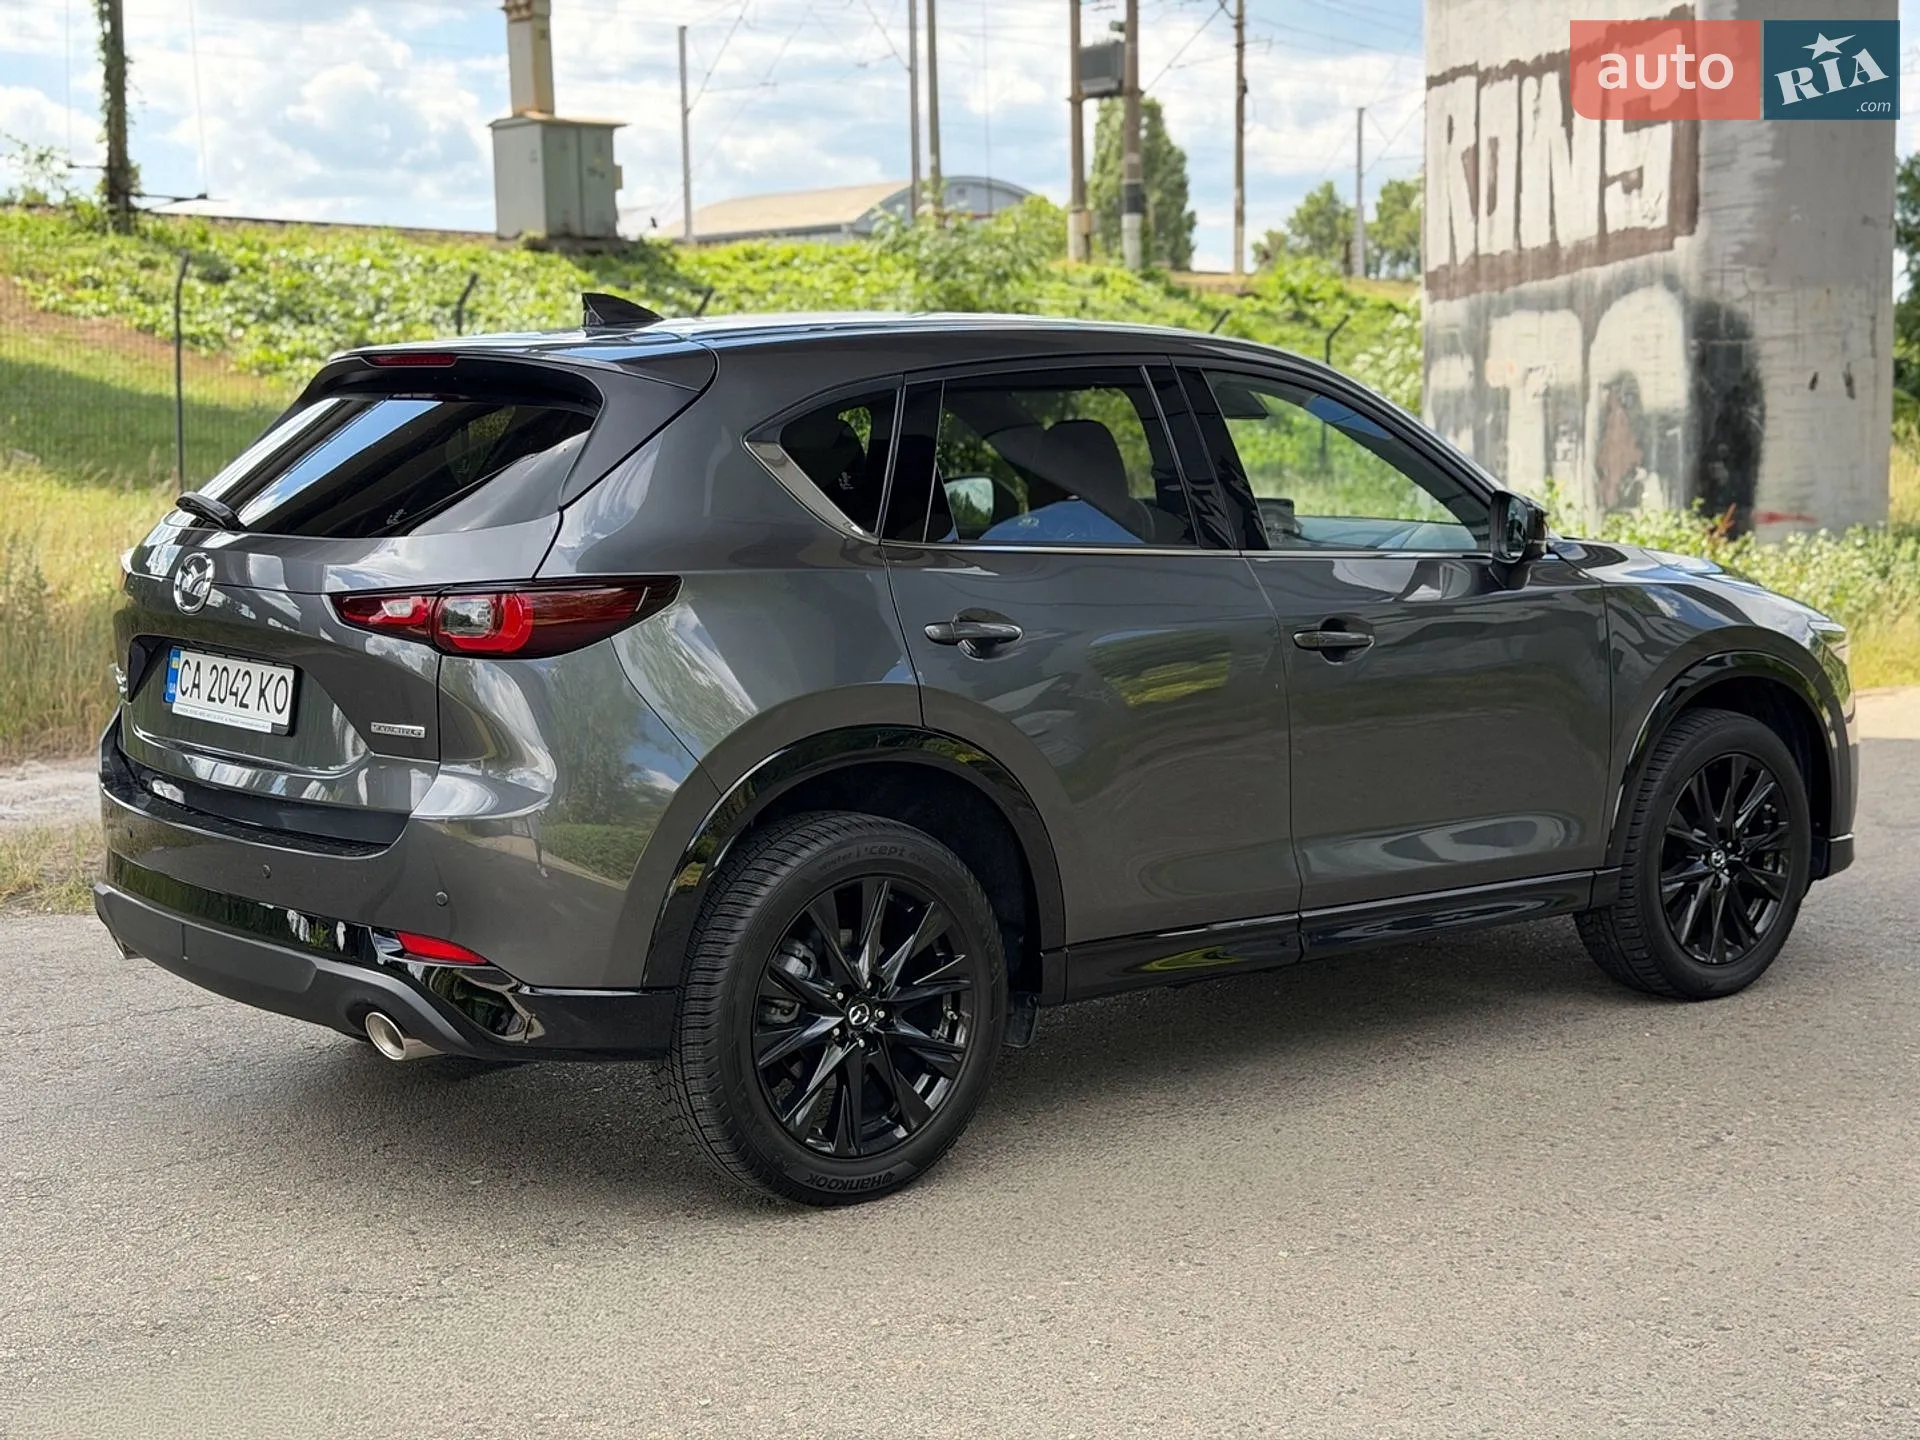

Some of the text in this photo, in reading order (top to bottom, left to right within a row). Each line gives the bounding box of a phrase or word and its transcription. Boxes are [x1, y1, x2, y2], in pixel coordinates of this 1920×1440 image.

[179, 659, 202, 699] CA
[206, 664, 253, 710] 2042
[256, 671, 289, 715] KO
